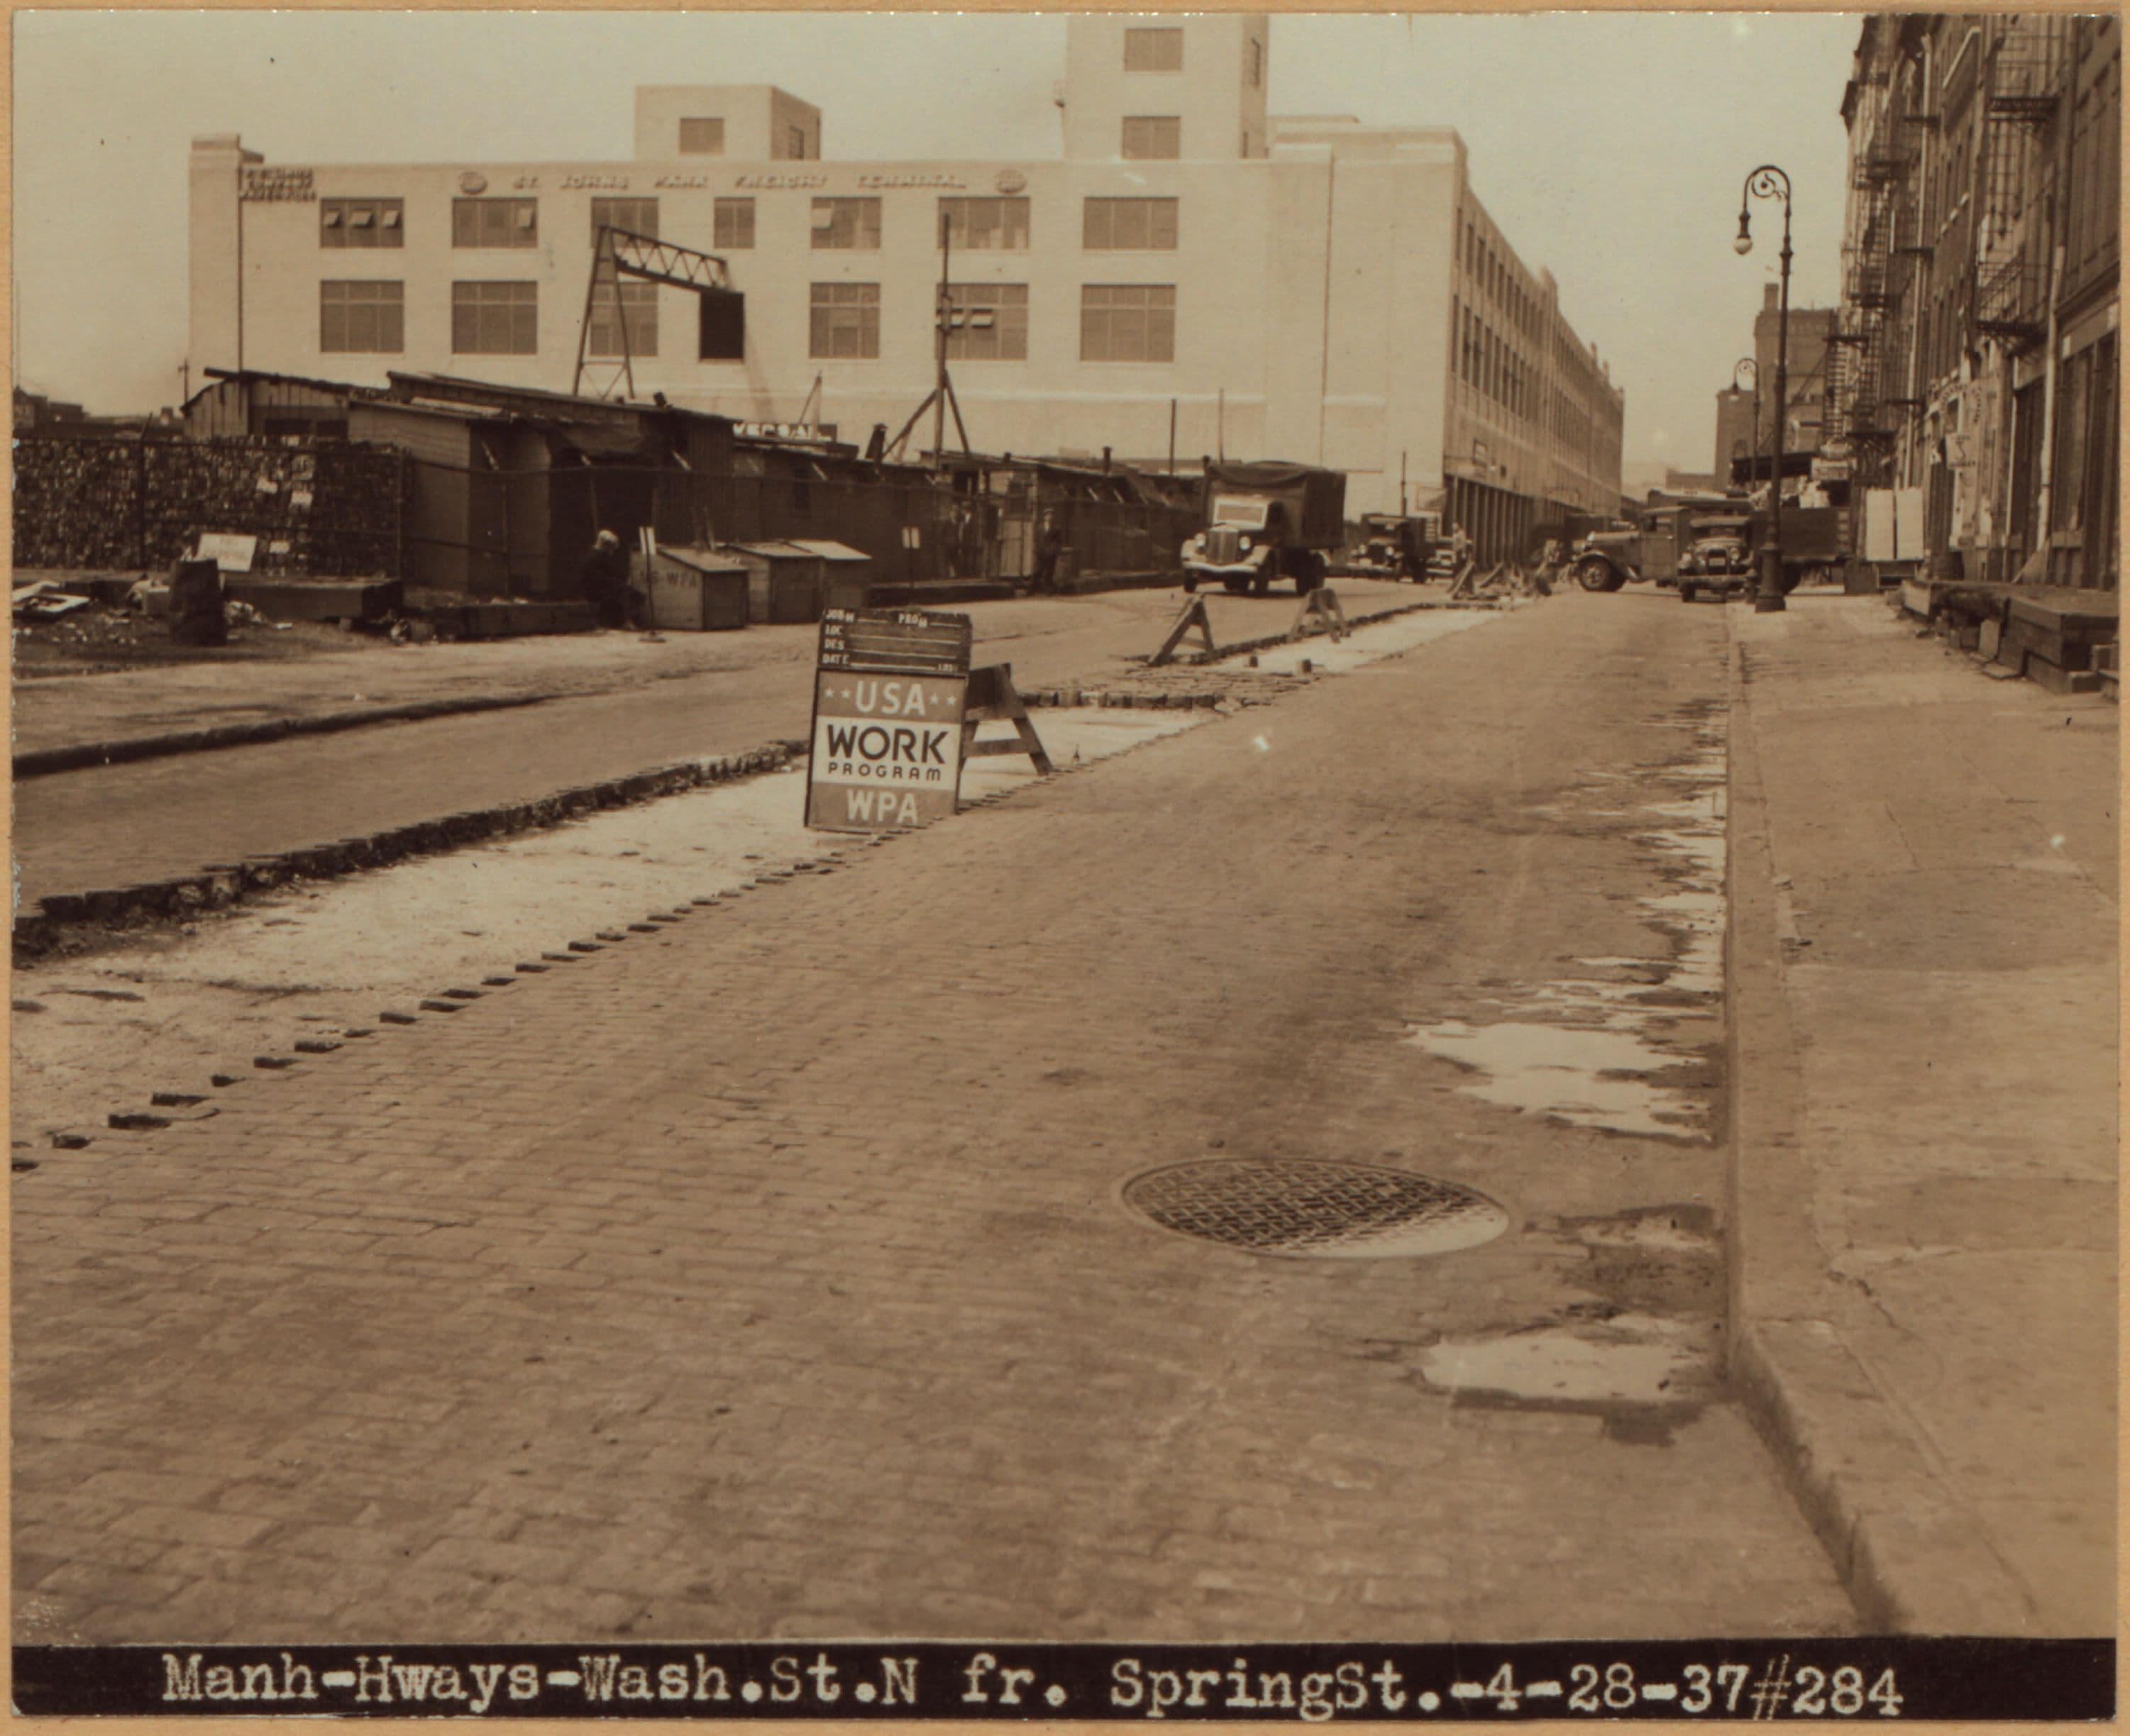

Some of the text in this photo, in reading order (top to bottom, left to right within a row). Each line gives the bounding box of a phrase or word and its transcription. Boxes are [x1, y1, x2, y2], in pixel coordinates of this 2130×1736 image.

[855, 680, 926, 716] USA
[827, 724, 949, 764] WORK
[827, 762, 941, 781] PROGRAM
[846, 788, 919, 824] WPA
